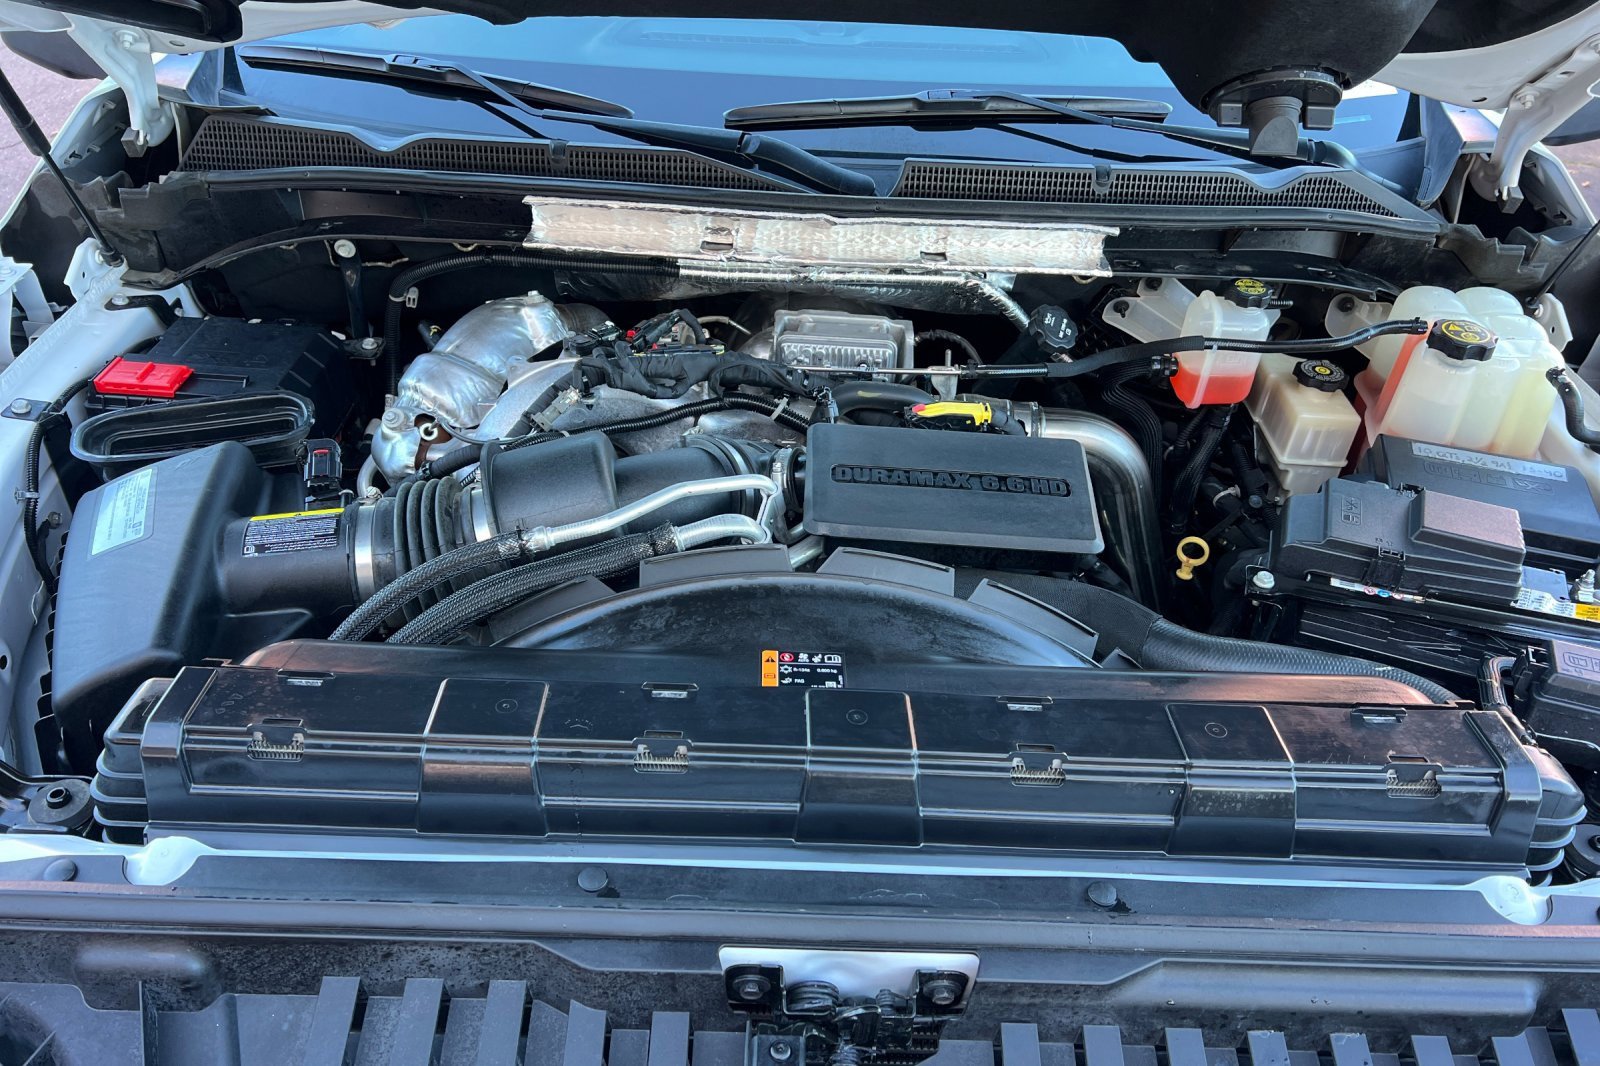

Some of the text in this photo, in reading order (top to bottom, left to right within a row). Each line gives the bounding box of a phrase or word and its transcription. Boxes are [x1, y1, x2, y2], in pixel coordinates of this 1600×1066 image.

[835, 466, 1069, 496] DURAMAX 6.6 HD
